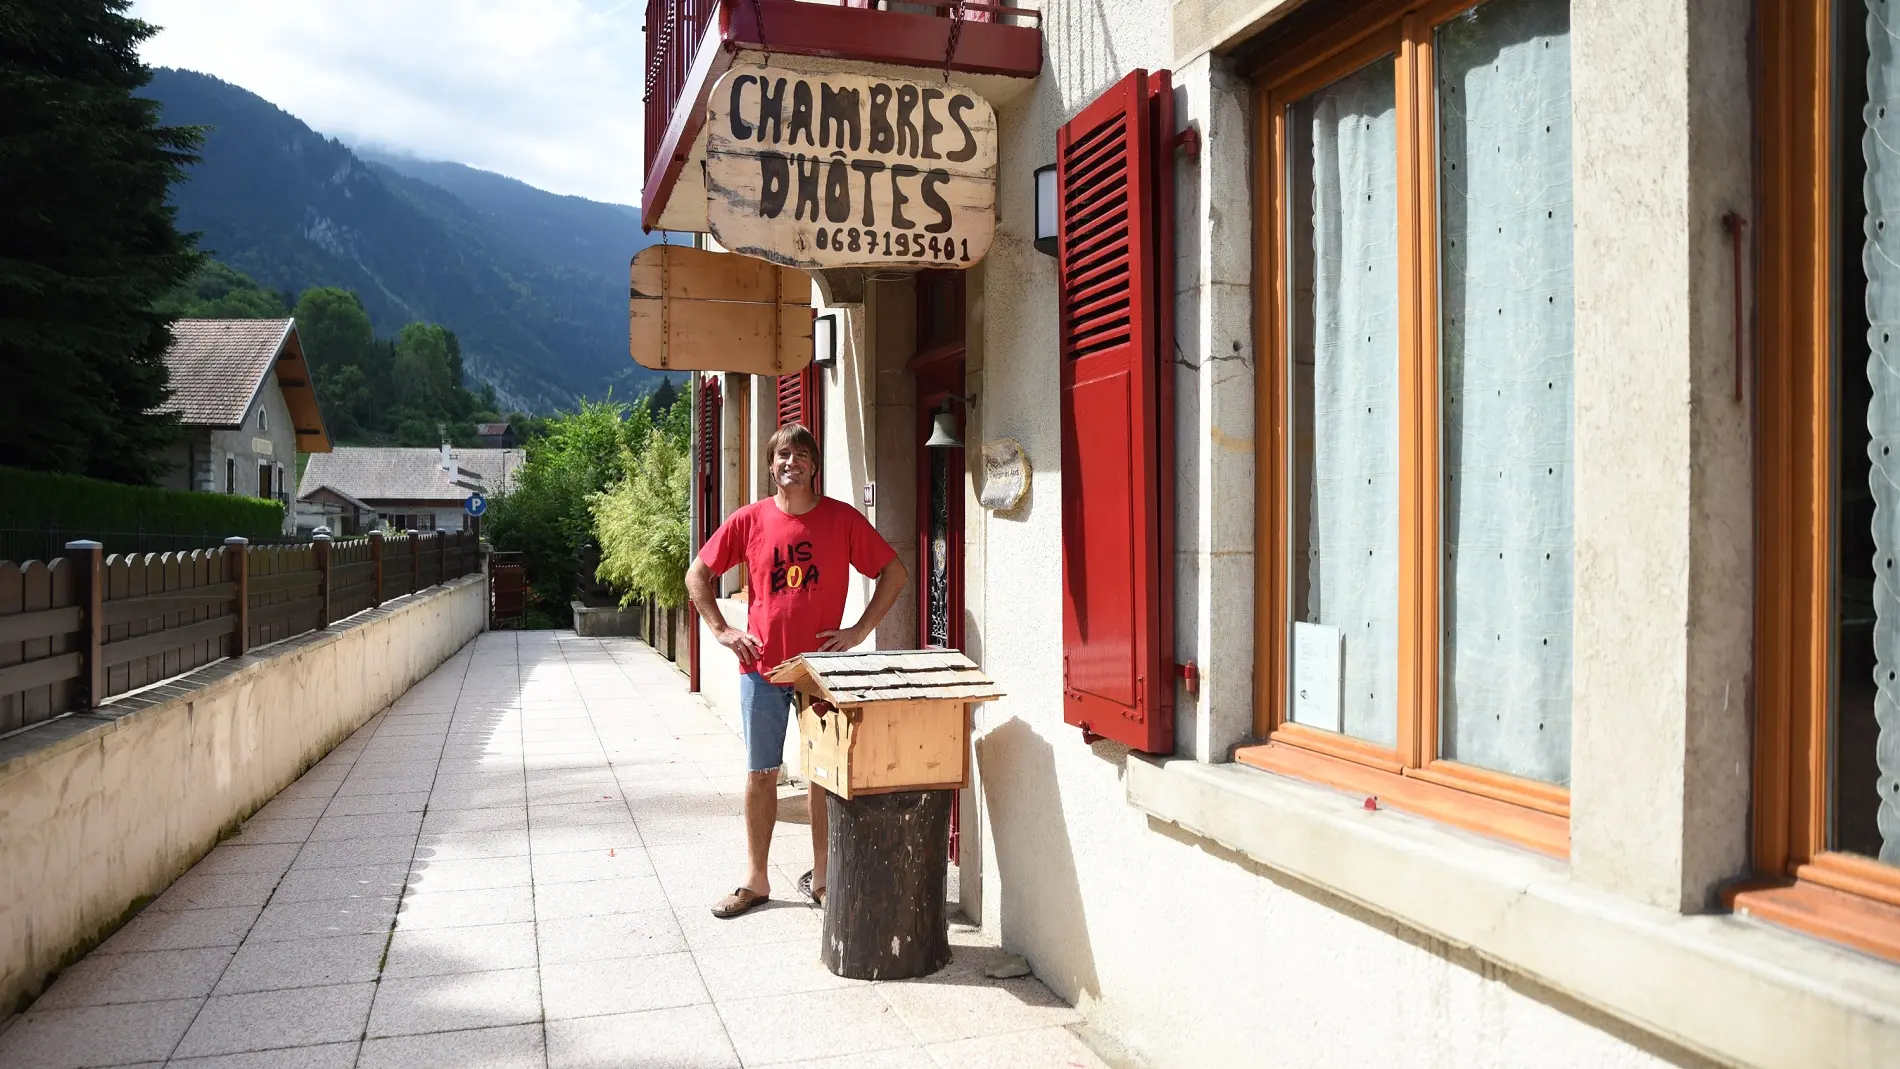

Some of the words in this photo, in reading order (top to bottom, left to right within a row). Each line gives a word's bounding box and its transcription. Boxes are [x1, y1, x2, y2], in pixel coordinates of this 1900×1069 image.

[730, 74, 977, 162] CHAMBRES
[759, 151, 953, 234] D'HÔTES
[816, 227, 970, 261] 0687195401
[472, 498, 482, 511] P
[773, 541, 813, 568] LIS
[771, 563, 820, 593] BOA
